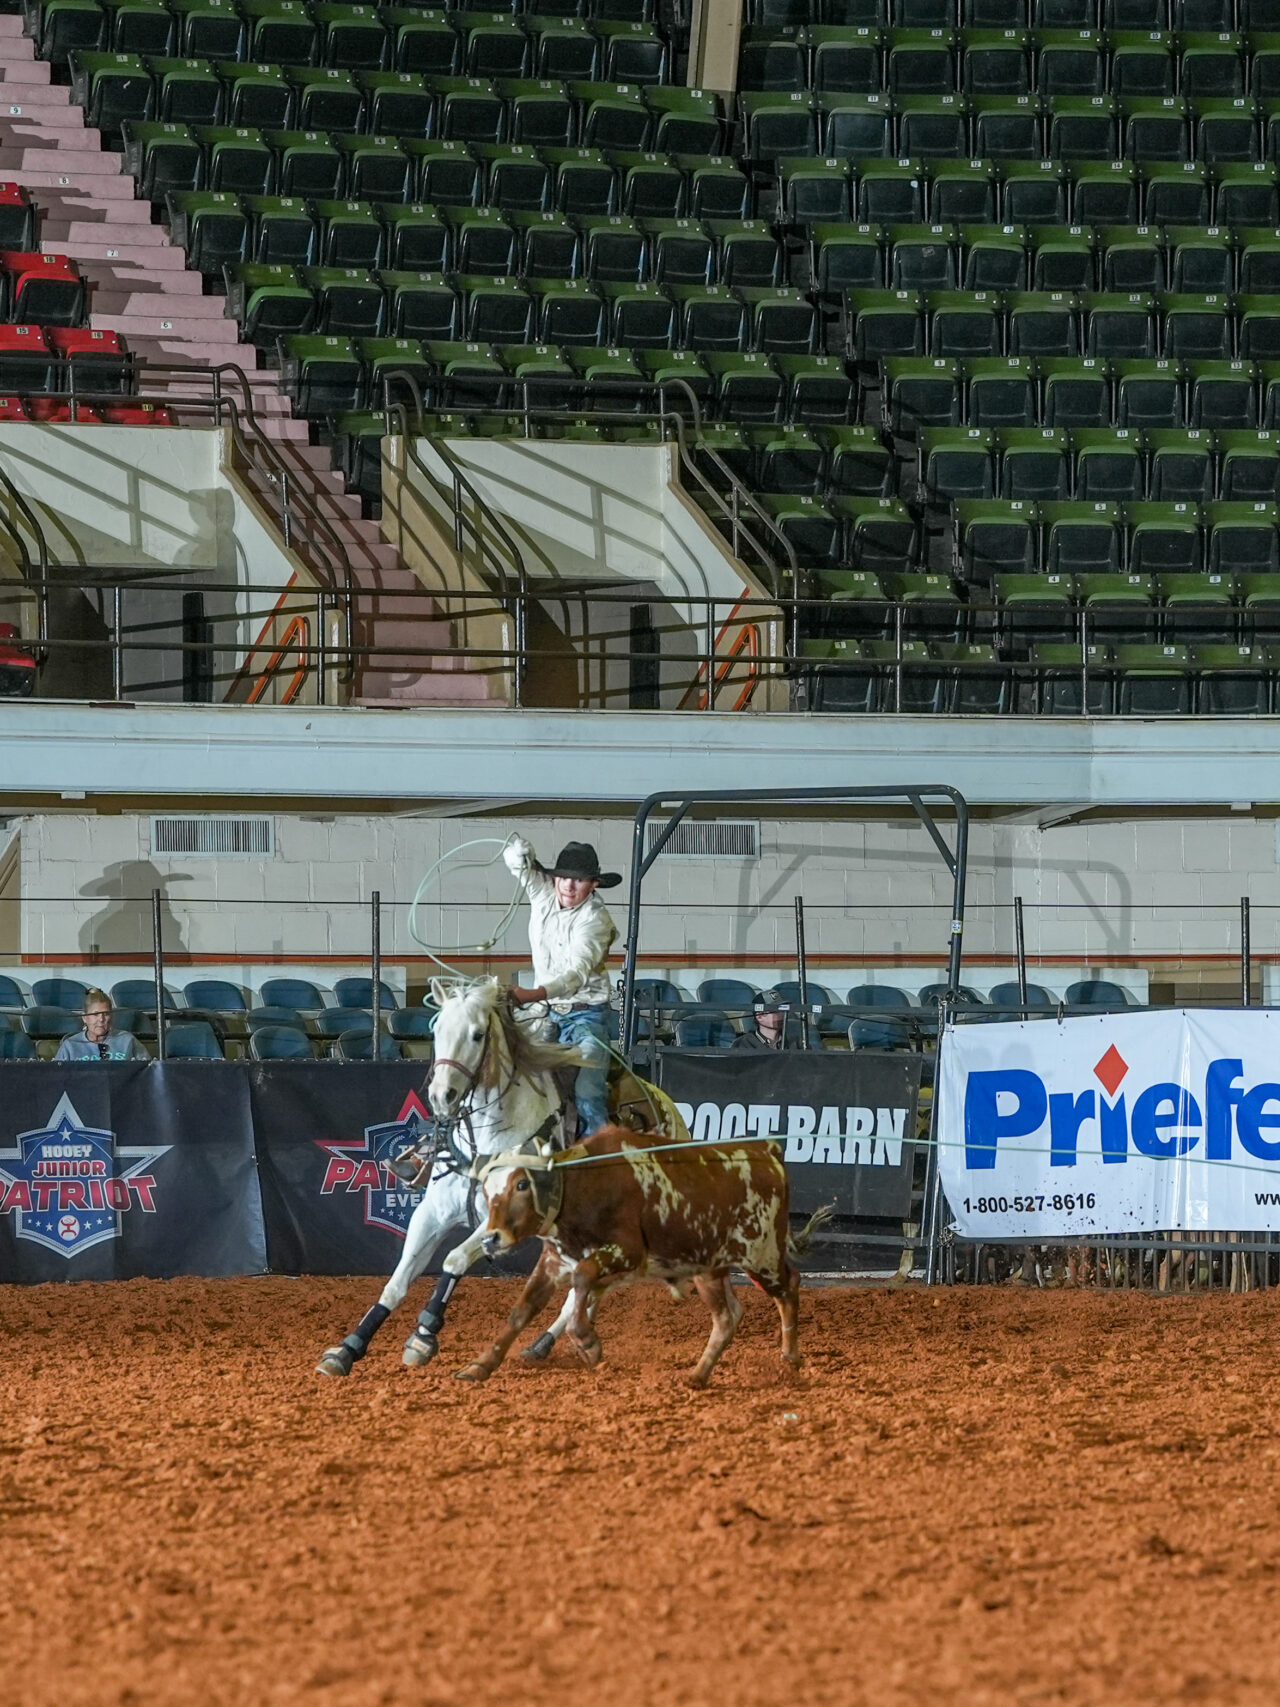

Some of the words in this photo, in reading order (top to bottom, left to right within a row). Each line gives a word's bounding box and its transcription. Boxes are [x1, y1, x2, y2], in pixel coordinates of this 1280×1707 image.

[784, 1104, 906, 1166] BARN
[41, 1144, 93, 1158] HOOEY
[32, 1160, 107, 1178] JUNIOR
[0, 1175, 157, 1215] ATRIOT
[964, 1192, 1096, 1214] 1-800-527-8616
